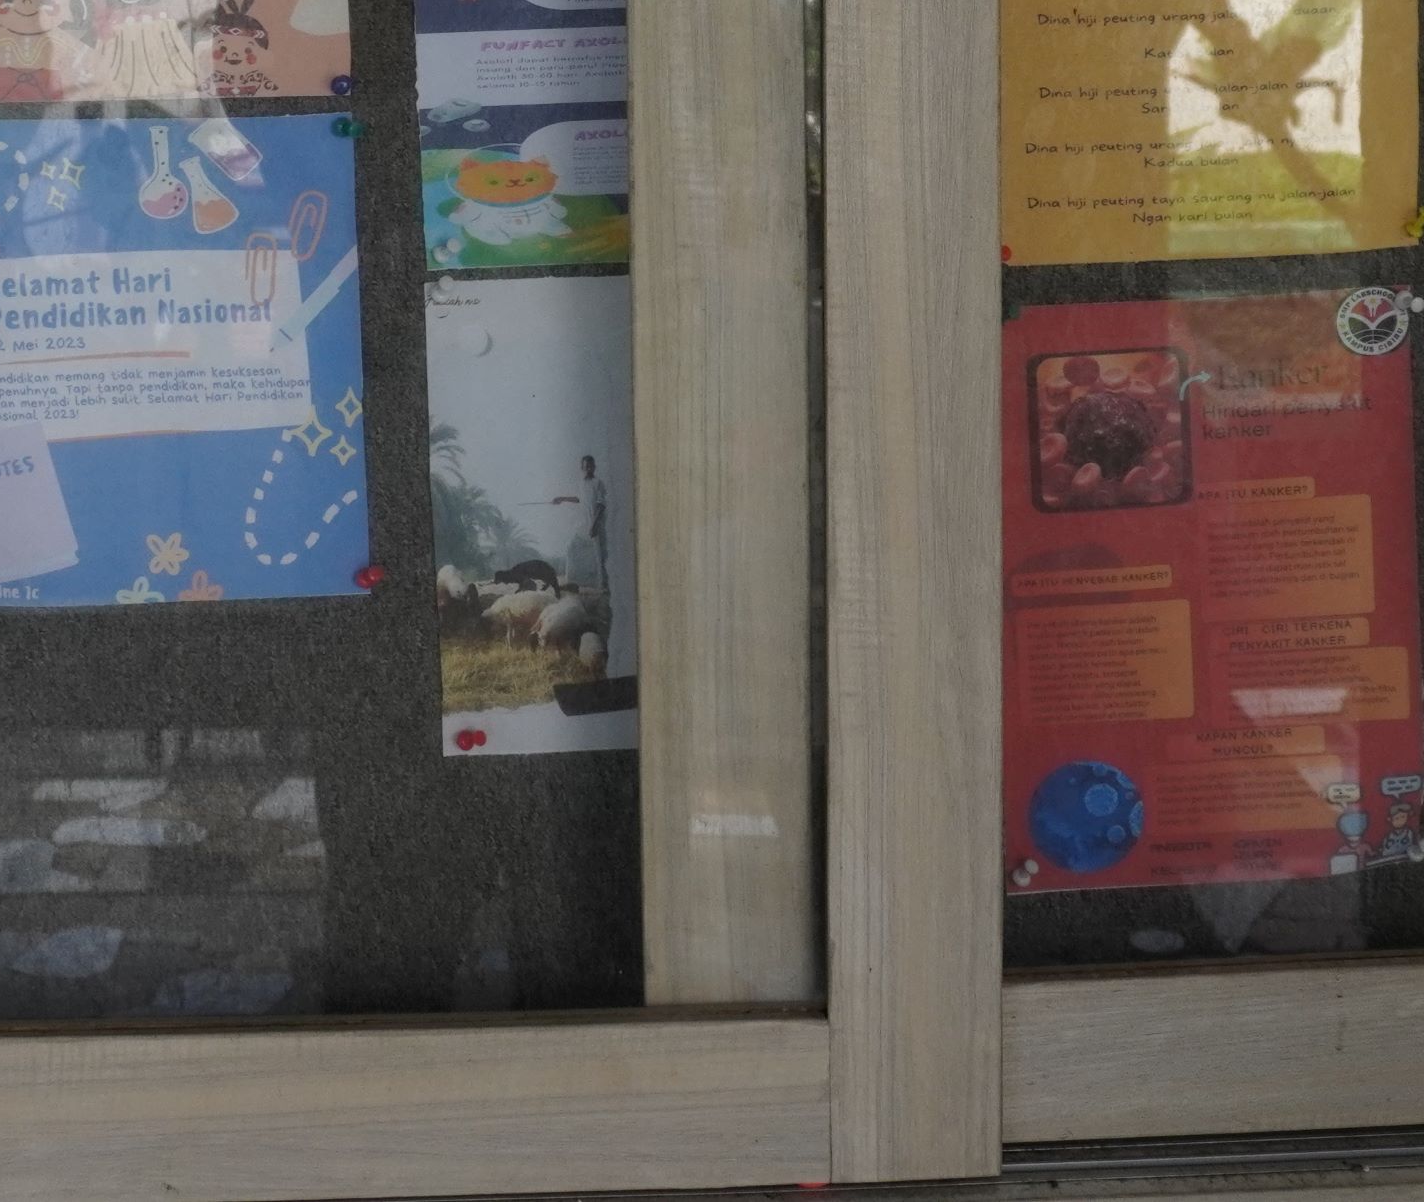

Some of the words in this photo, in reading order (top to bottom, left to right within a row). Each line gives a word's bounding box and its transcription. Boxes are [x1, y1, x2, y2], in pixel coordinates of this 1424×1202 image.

[1102, 11, 1156, 27] peuting
[112, 268, 171, 293] Hari
[157, 299, 272, 325] Nasional
[12, 337, 39, 352] Mei
[44, 335, 86, 350] 2023
[1202, 423, 1273, 440] kanker
[1294, 620, 1352, 633] TERKENA
